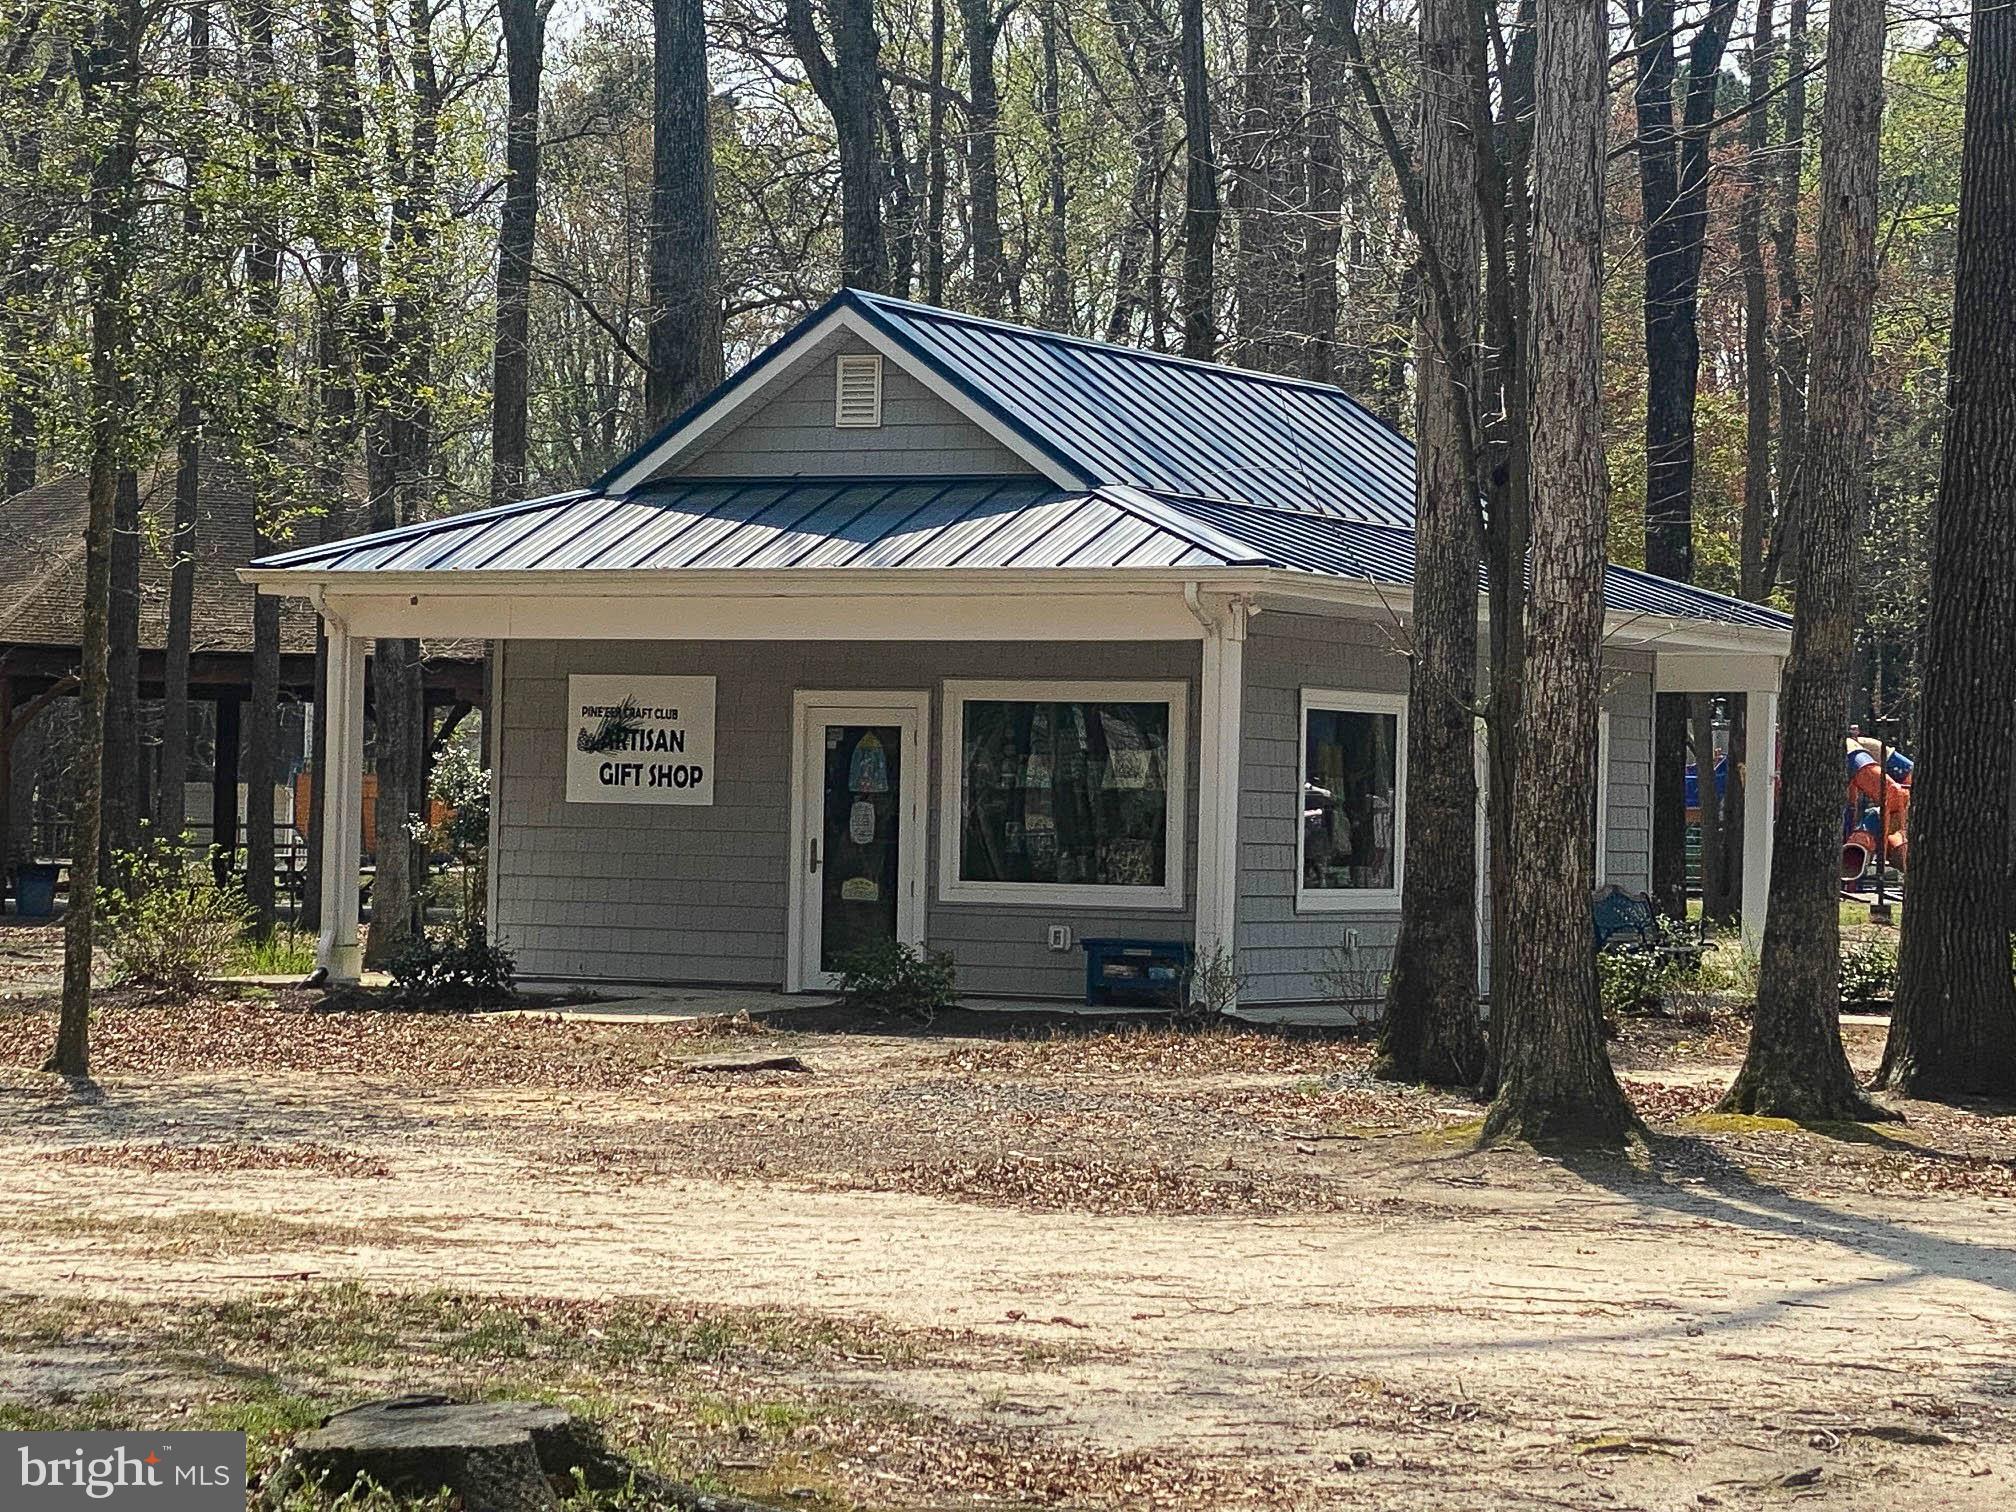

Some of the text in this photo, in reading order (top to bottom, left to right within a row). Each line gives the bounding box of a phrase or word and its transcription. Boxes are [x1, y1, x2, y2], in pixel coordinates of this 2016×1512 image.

[624, 708, 652, 720] CRAFT
[654, 709, 678, 720] CLUB
[600, 762, 703, 788] GIFT SHOP
